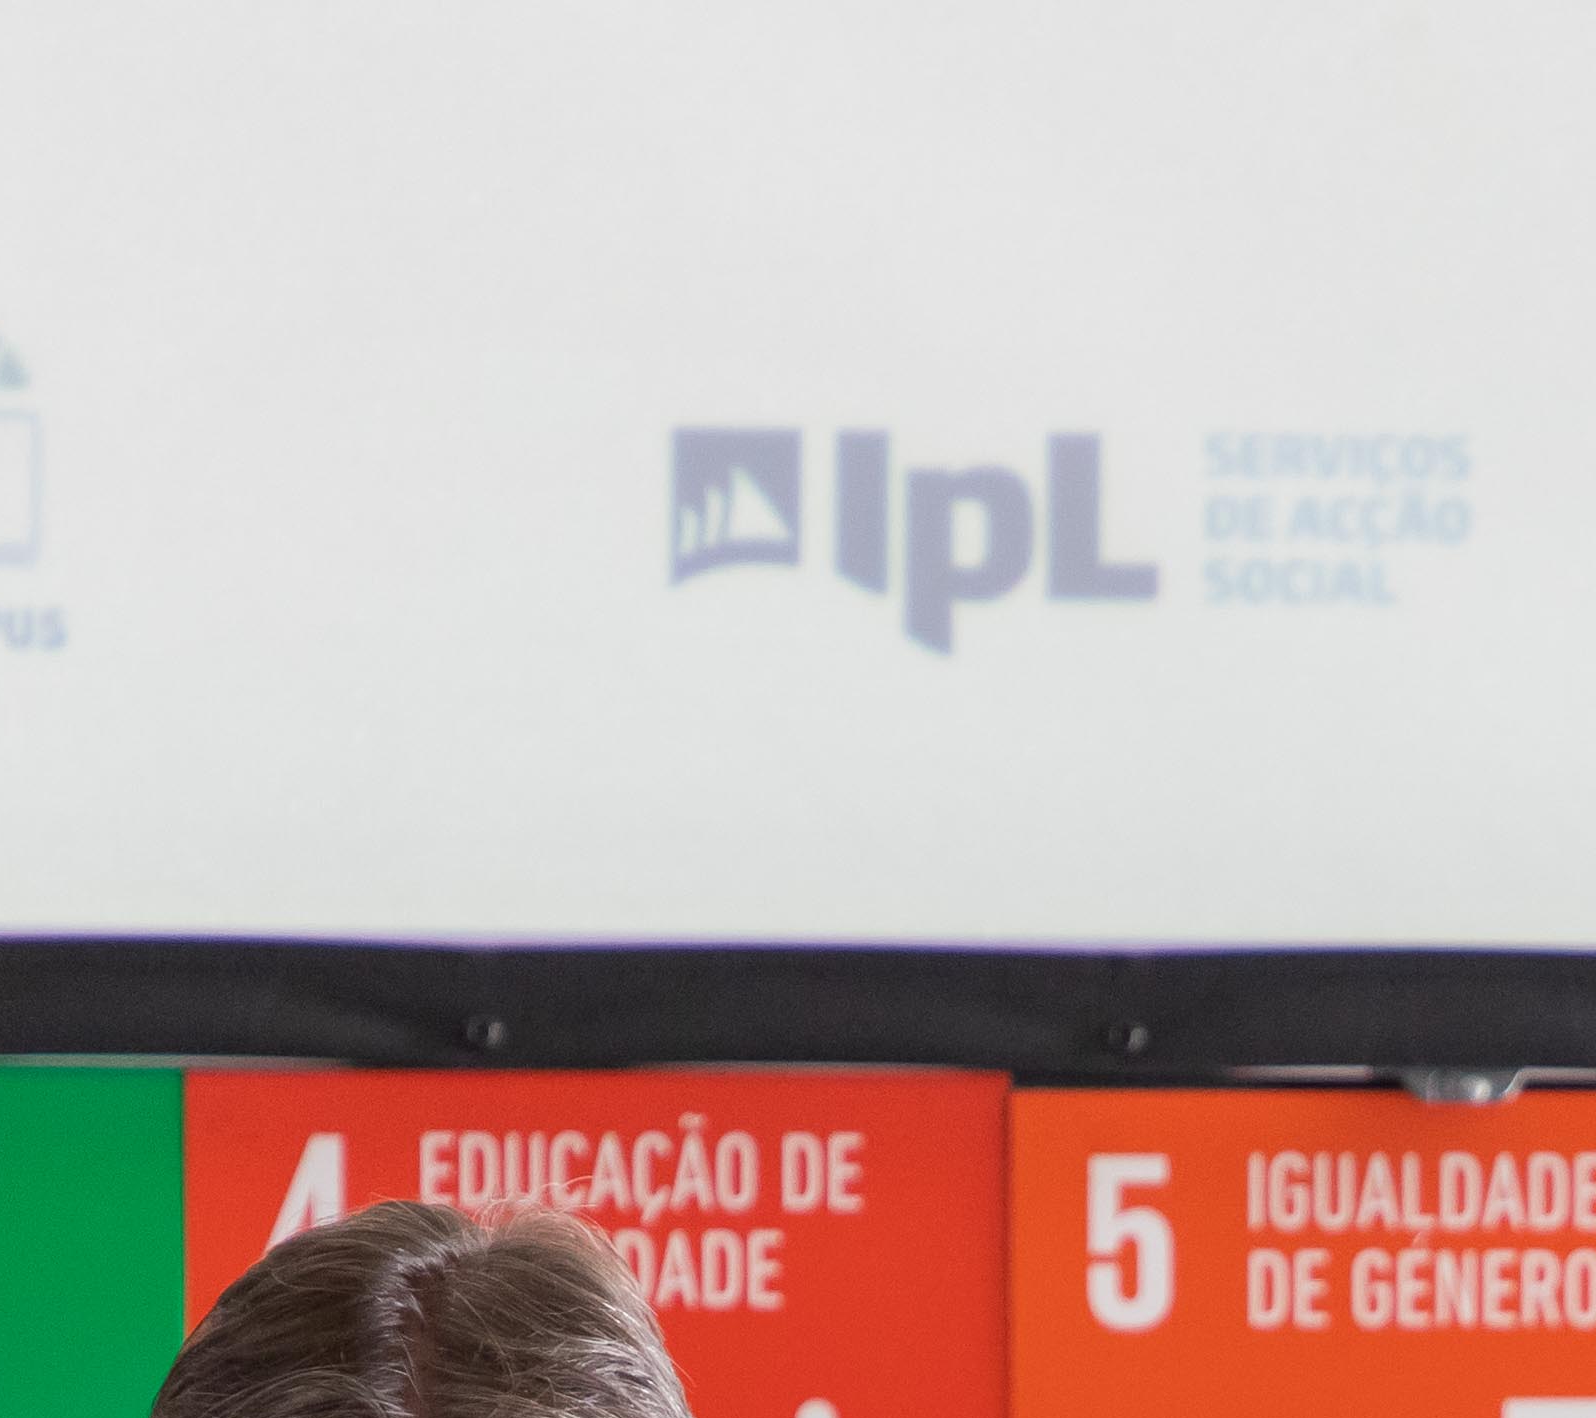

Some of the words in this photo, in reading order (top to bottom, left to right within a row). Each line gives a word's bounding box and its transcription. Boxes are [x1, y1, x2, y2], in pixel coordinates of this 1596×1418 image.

[1204, 430, 1474, 485] SERVIÇOS
[1204, 496, 1271, 541] DE
[1203, 559, 1398, 606] SOCIAL
[420, 1112, 760, 1226] EDUCAÇÃO
[781, 1132, 862, 1213] DE
[1087, 1154, 1174, 1332] 5
[1247, 1248, 1329, 1329] DE
